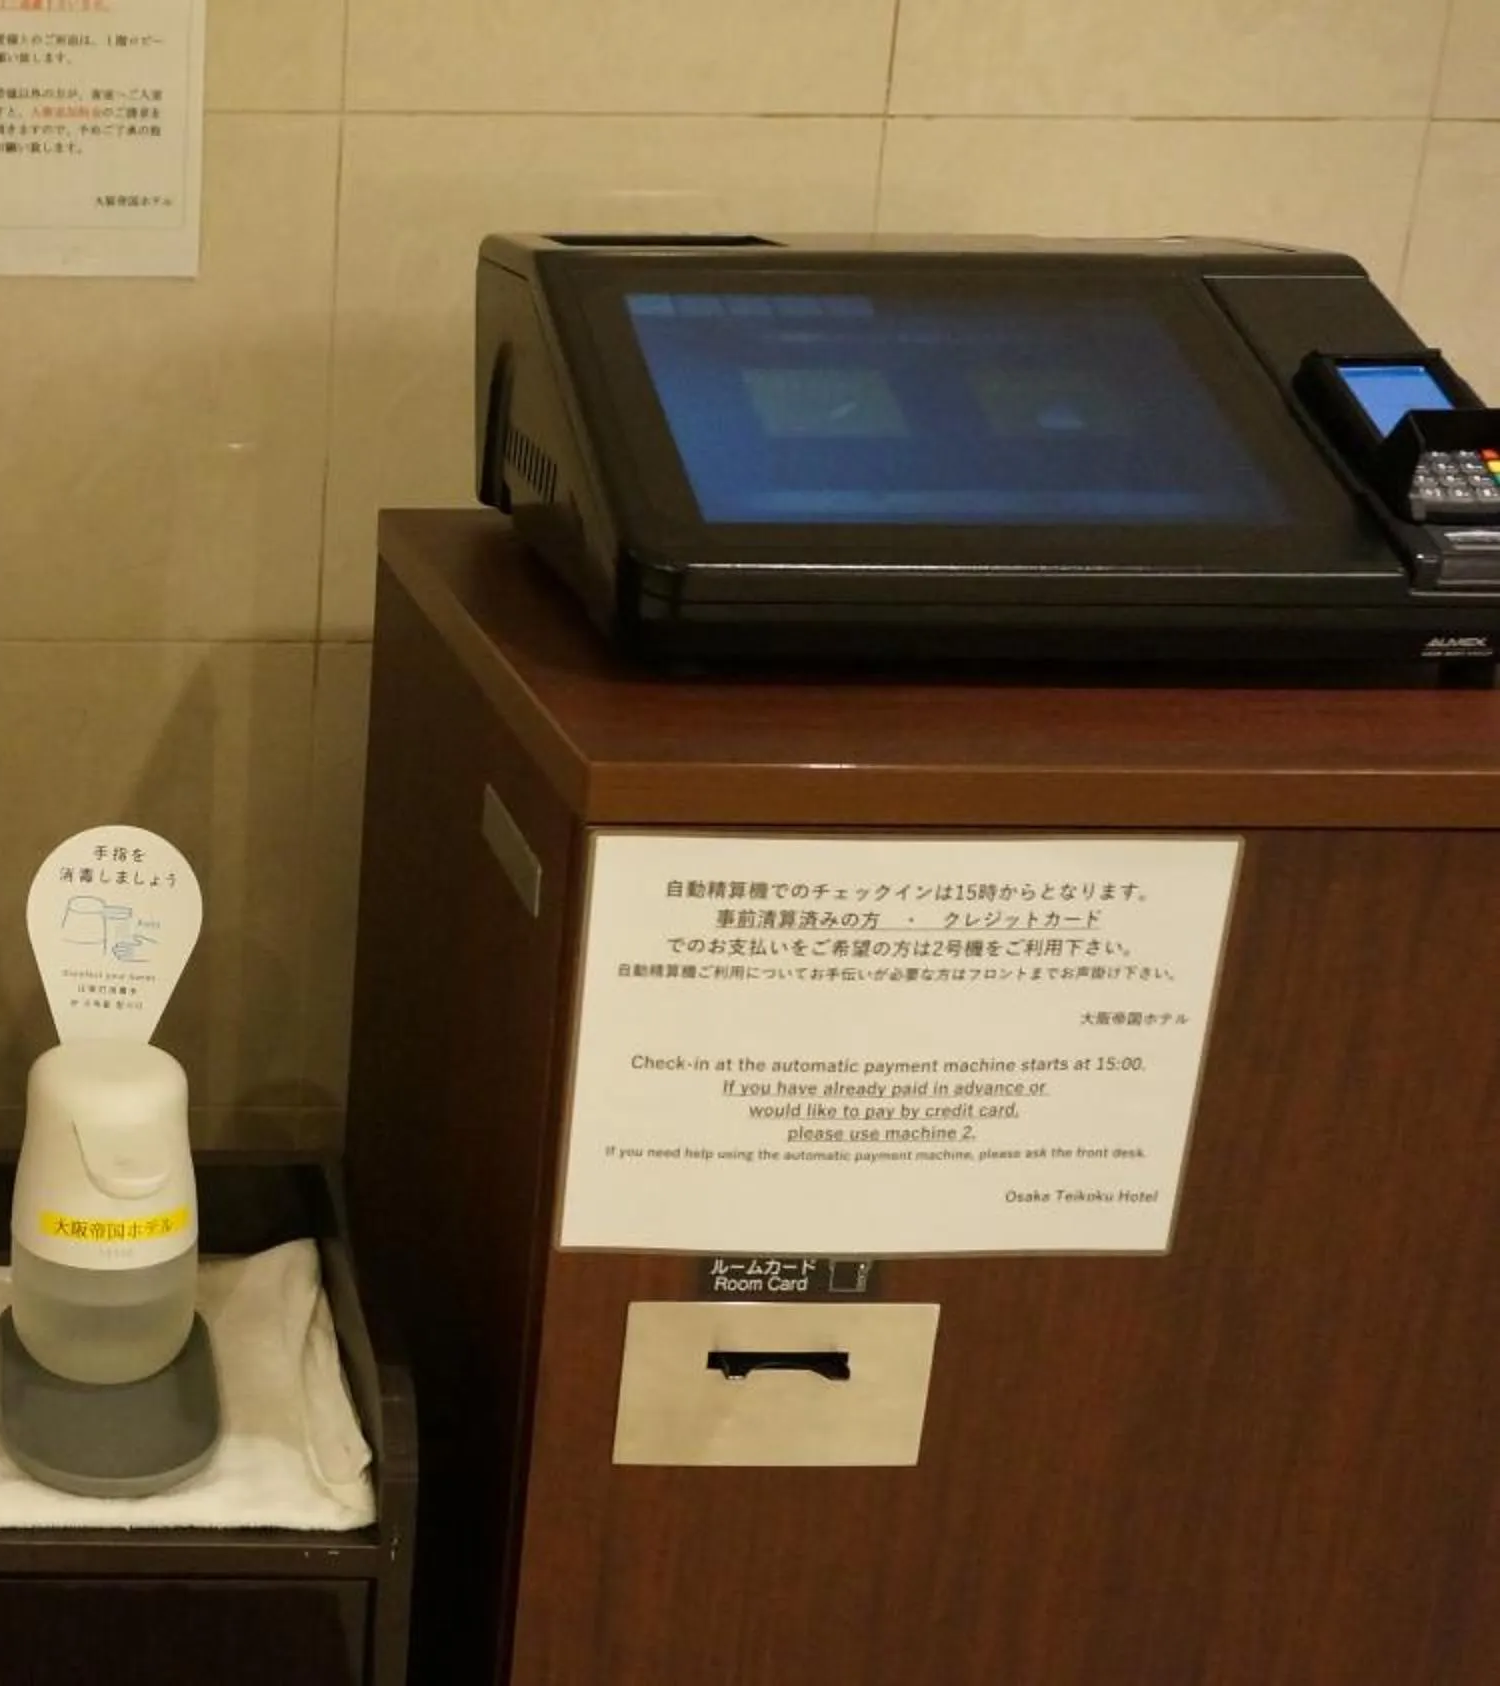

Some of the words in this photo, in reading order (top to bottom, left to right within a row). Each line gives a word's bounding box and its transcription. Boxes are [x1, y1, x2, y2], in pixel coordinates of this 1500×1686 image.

[94, 845, 145, 863] 手指を
[59, 866, 178, 888] 消毒しましょう
[667, 880, 1147, 901] 自動精算機でのチェックインは15時からとなります。
[1080, 1010, 1189, 1027] 大阪帝国ホテル
[631, 1055, 709, 1071] Check-in
[714, 1058, 732, 1071] at
[738, 1057, 765, 1072] the
[771, 1058, 859, 1073] automatic
[864, 1060, 937, 1076] payment
[943, 1057, 1015, 1072] machine
[1021, 1057, 1068, 1071] starts
[1073, 1058, 1090, 1071] at
[723, 1080, 735, 1095] If
[741, 1083, 771, 1098] you
[777, 1081, 817, 1095] have
[823, 1081, 887, 1098] already
[891, 1081, 928, 1098] paid
[933, 1081, 948, 1095] in
[954, 1081, 1024, 1095] advance
[1029, 1082, 1045, 1095] or
[750, 1102, 800, 1118] would
[807, 1103, 837, 1118] like
[843, 1104, 859, 1118] to
[865, 1106, 895, 1121] pay
[900, 1103, 919, 1120] by
[925, 1102, 973, 1118] credit
[788, 1125, 843, 1142] please
[850, 1129, 880, 1140] use
[885, 1125, 956, 1140] machine
[605, 1146, 615, 1156] If
[620, 1148, 643, 1159] you
[648, 1147, 680, 1159] need
[684, 1147, 712, 1160] help
[717, 1148, 751, 1162] using
[757, 1148, 779, 1160] the
[783, 1148, 848, 1161] automatic
[853, 1148, 912, 1163] payment
[978, 1147, 1021, 1161] please
[1025, 1146, 1046, 1159] ask
[1051, 1146, 1072, 1158] the
[1077, 1145, 1108, 1158] front
[1005, 1190, 1050, 1203] Osaka
[1056, 1189, 1113, 1203] Teikoku
[1118, 1189, 1158, 1203] Hotel
[54, 1216, 176, 1242] 大阪帝国ホテル
[710, 1258, 817, 1275] ルームカード
[714, 1276, 763, 1291] Room
[767, 1276, 809, 1291] Card
